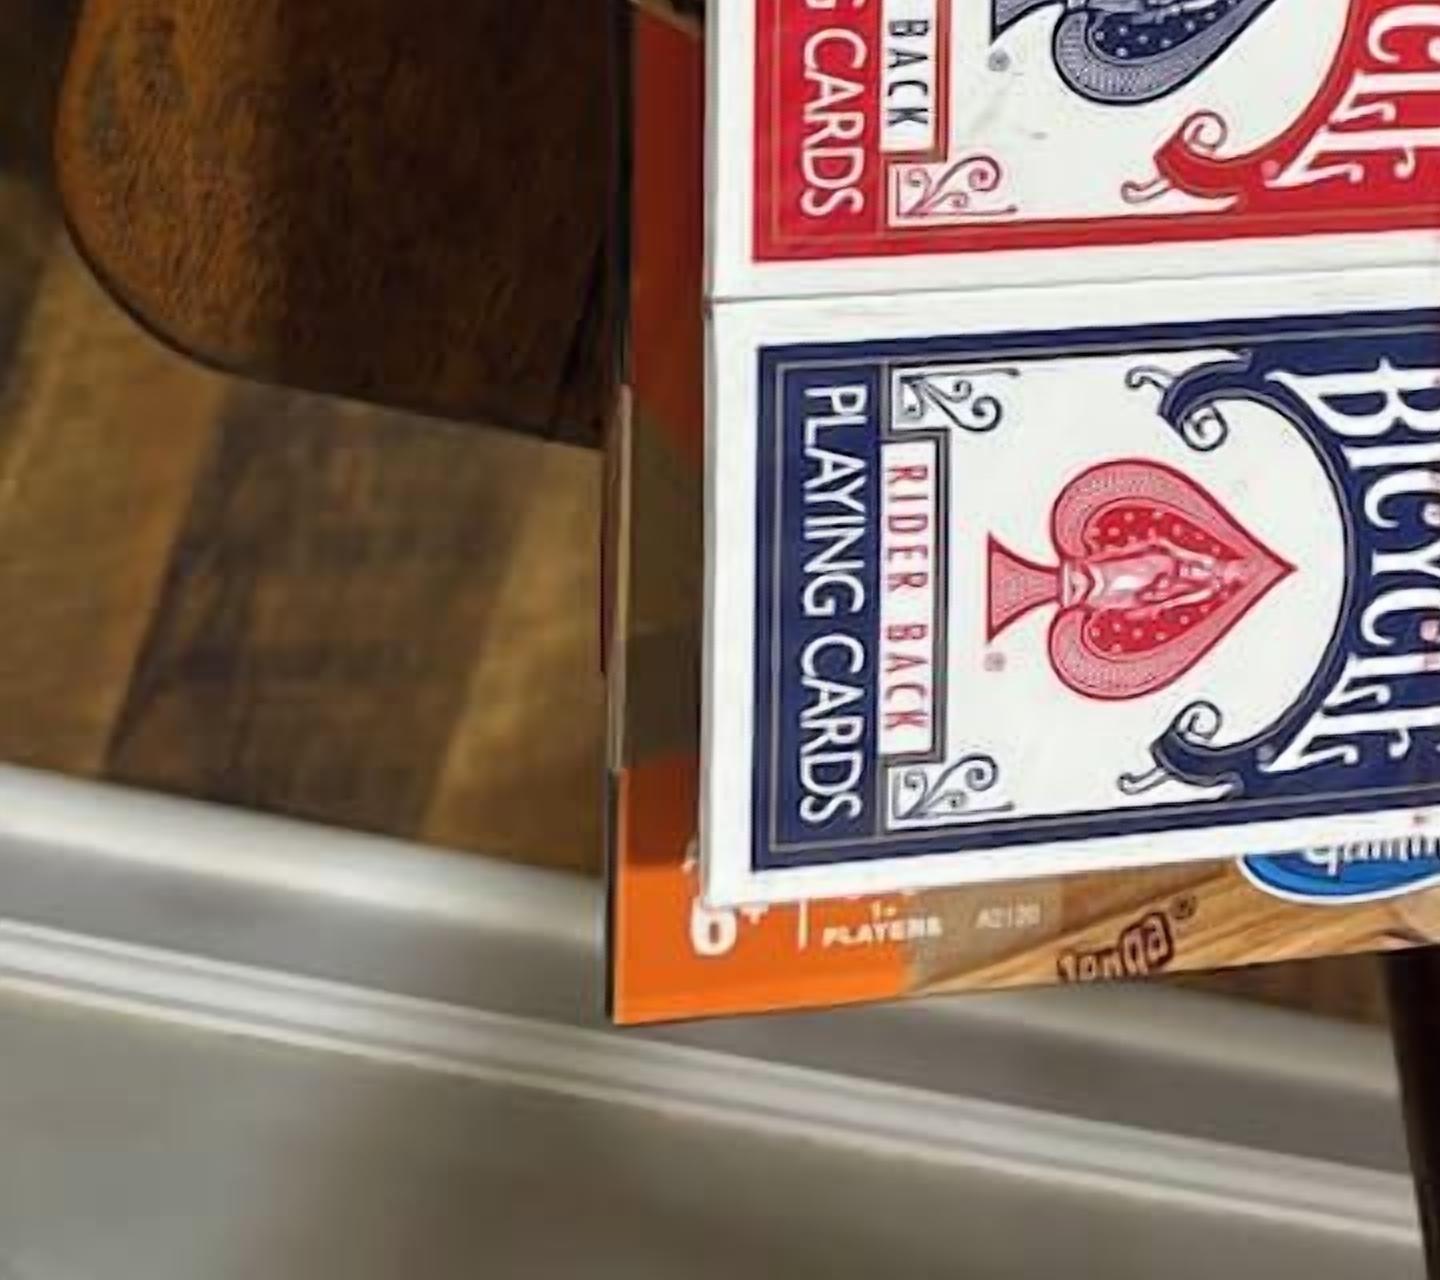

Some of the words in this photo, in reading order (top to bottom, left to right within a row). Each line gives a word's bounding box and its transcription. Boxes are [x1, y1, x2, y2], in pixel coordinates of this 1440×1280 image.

[799, 28, 868, 217] CARDS
[887, 20, 931, 127] BACK
[801, 385, 868, 616] PLAYING
[887, 464, 931, 590] RIDER
[800, 633, 865, 823] CARDS
[884, 623, 930, 732] BACK
[822, 915, 942, 947] PLAYERS
